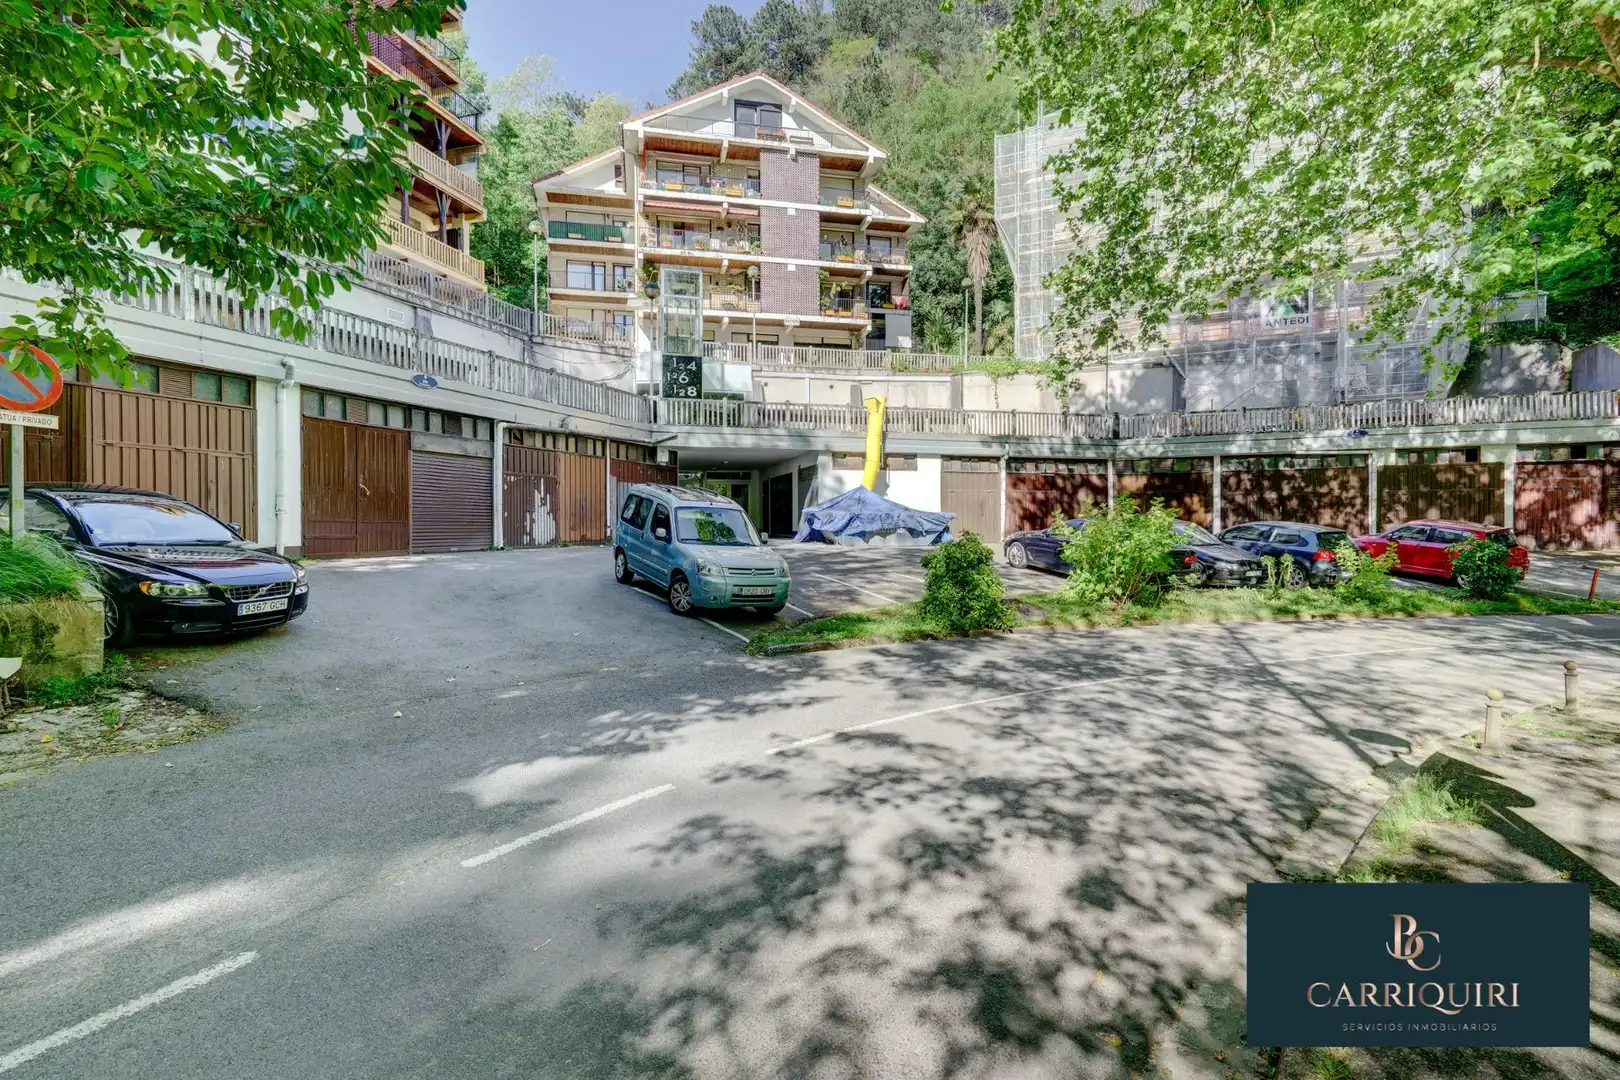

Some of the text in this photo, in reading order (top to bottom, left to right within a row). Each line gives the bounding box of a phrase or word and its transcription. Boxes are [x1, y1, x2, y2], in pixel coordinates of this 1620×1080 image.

[672, 357, 697, 371] 124
[667, 371, 689, 384] 126
[673, 384, 697, 397] 128
[22, 415, 53, 426] PRIVADO
[244, 602, 268, 613] 9367
